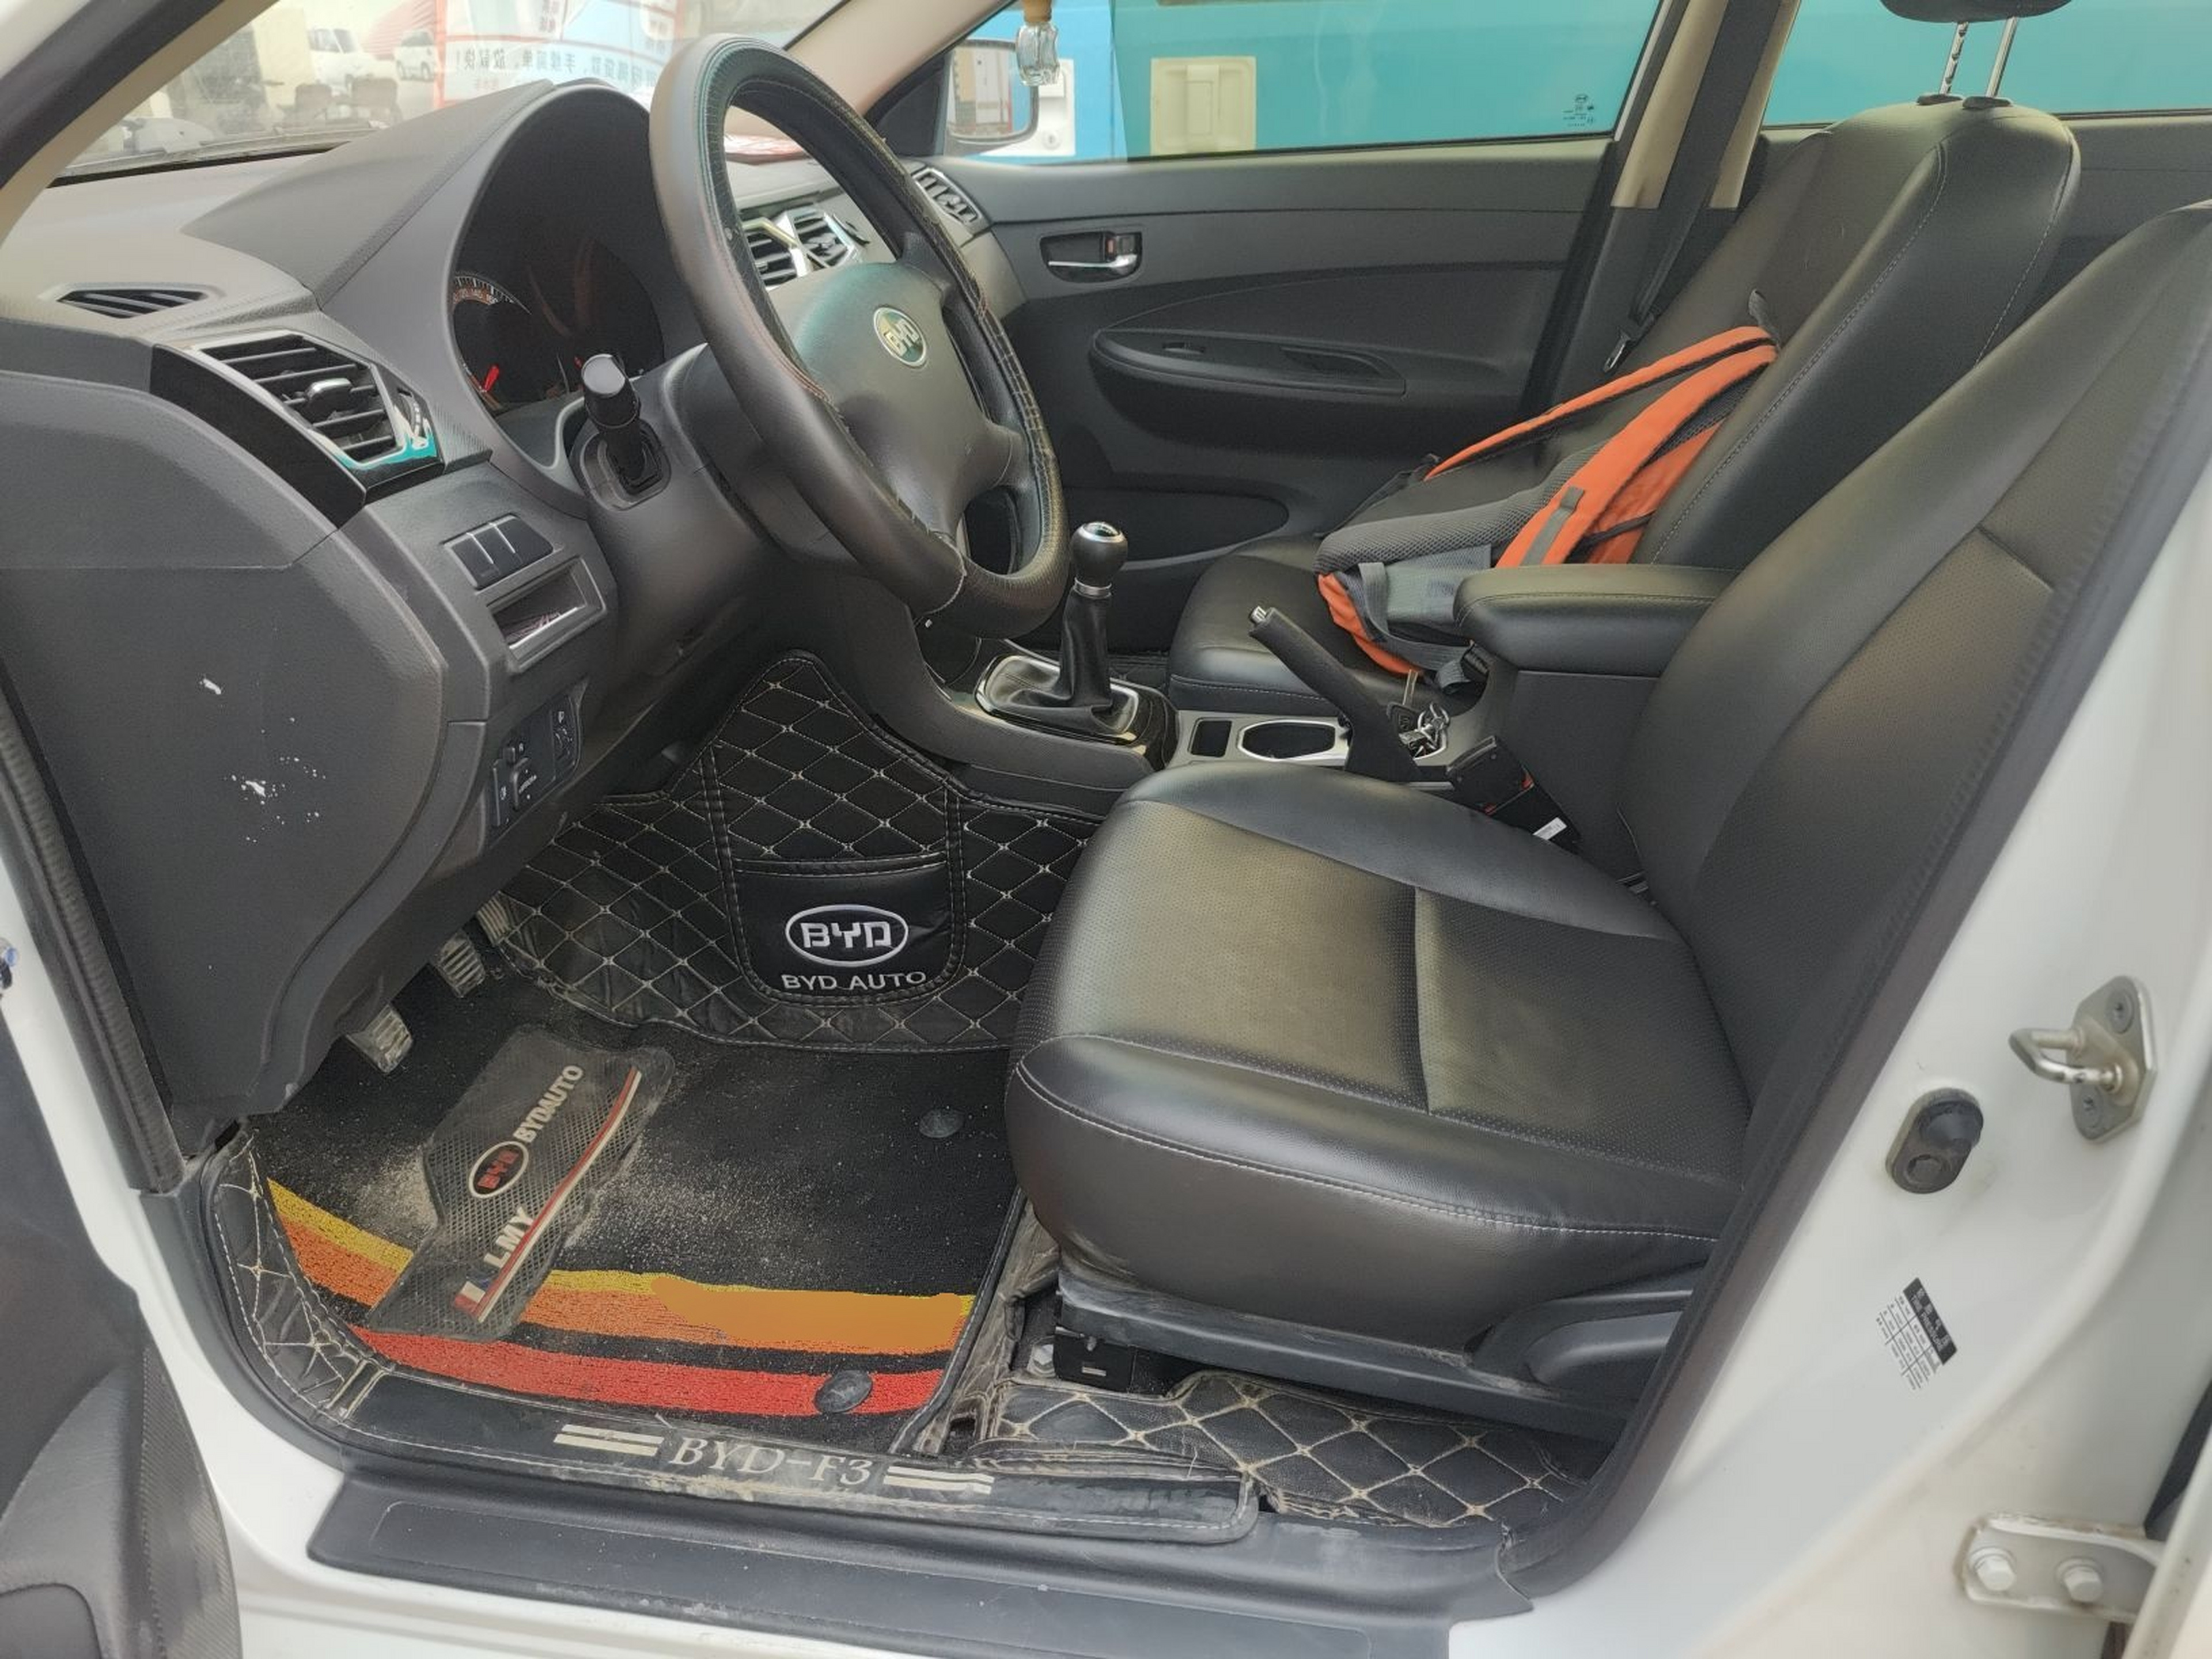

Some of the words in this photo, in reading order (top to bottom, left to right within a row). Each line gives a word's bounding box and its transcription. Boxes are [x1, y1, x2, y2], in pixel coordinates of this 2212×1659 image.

[883, 319, 920, 357] BYD
[800, 921, 892, 949] BYD
[781, 974, 836, 990] BYD
[849, 971, 926, 991] AUTO
[513, 1065, 583, 1143] BYDAUTO
[669, 1437, 873, 1486] BYD-F3
